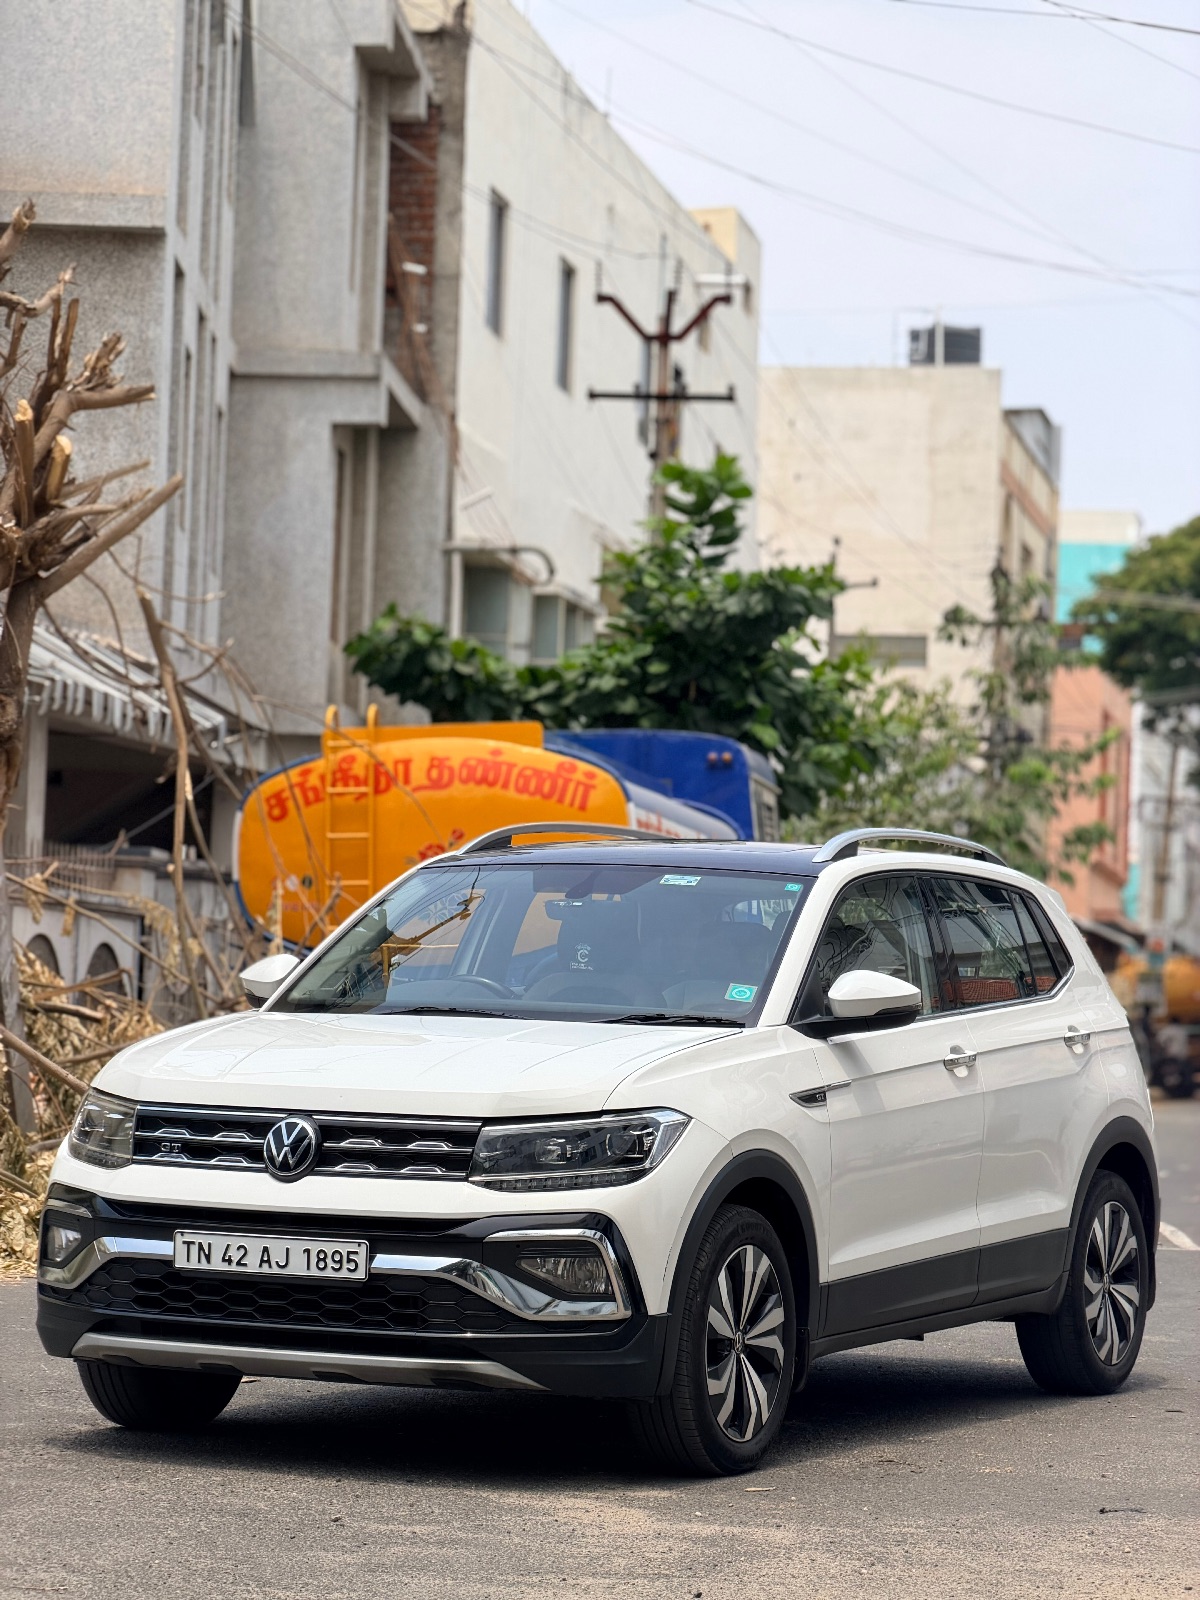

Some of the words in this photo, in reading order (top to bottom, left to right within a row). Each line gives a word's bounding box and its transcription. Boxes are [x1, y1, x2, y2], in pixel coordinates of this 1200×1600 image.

[412, 748, 598, 812] தண்ணீர்
[161, 1142, 182, 1152] GT
[182, 1240, 212, 1265] TN
[221, 1243, 248, 1267] 42
[258, 1245, 290, 1269] AJ
[302, 1248, 359, 1273] 1895
